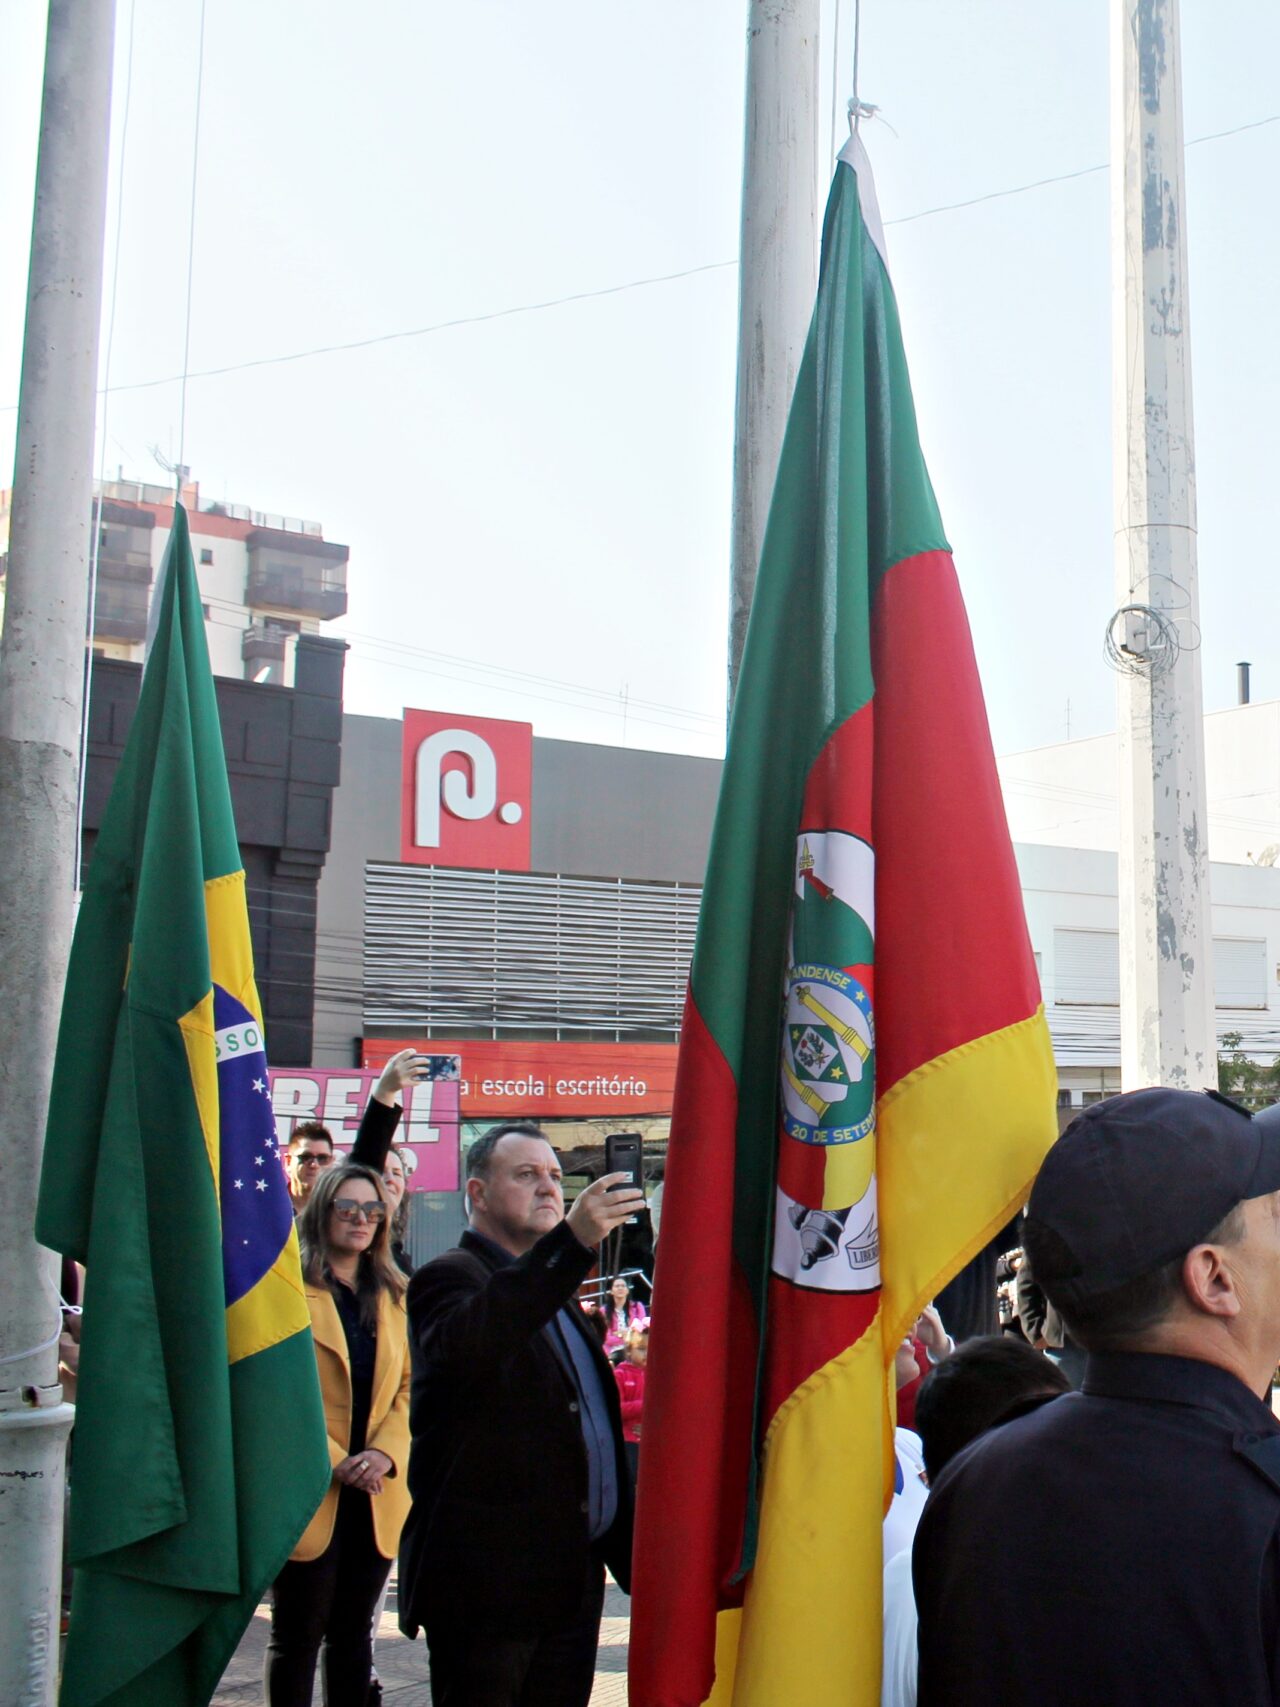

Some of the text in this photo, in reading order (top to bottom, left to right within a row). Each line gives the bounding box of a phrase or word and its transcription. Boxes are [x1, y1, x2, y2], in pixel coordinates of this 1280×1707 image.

[481, 1074, 545, 1097] escola
[556, 1074, 647, 1097] escritório
[791, 1124, 808, 1140] 20
[813, 1130, 828, 1142] DE
